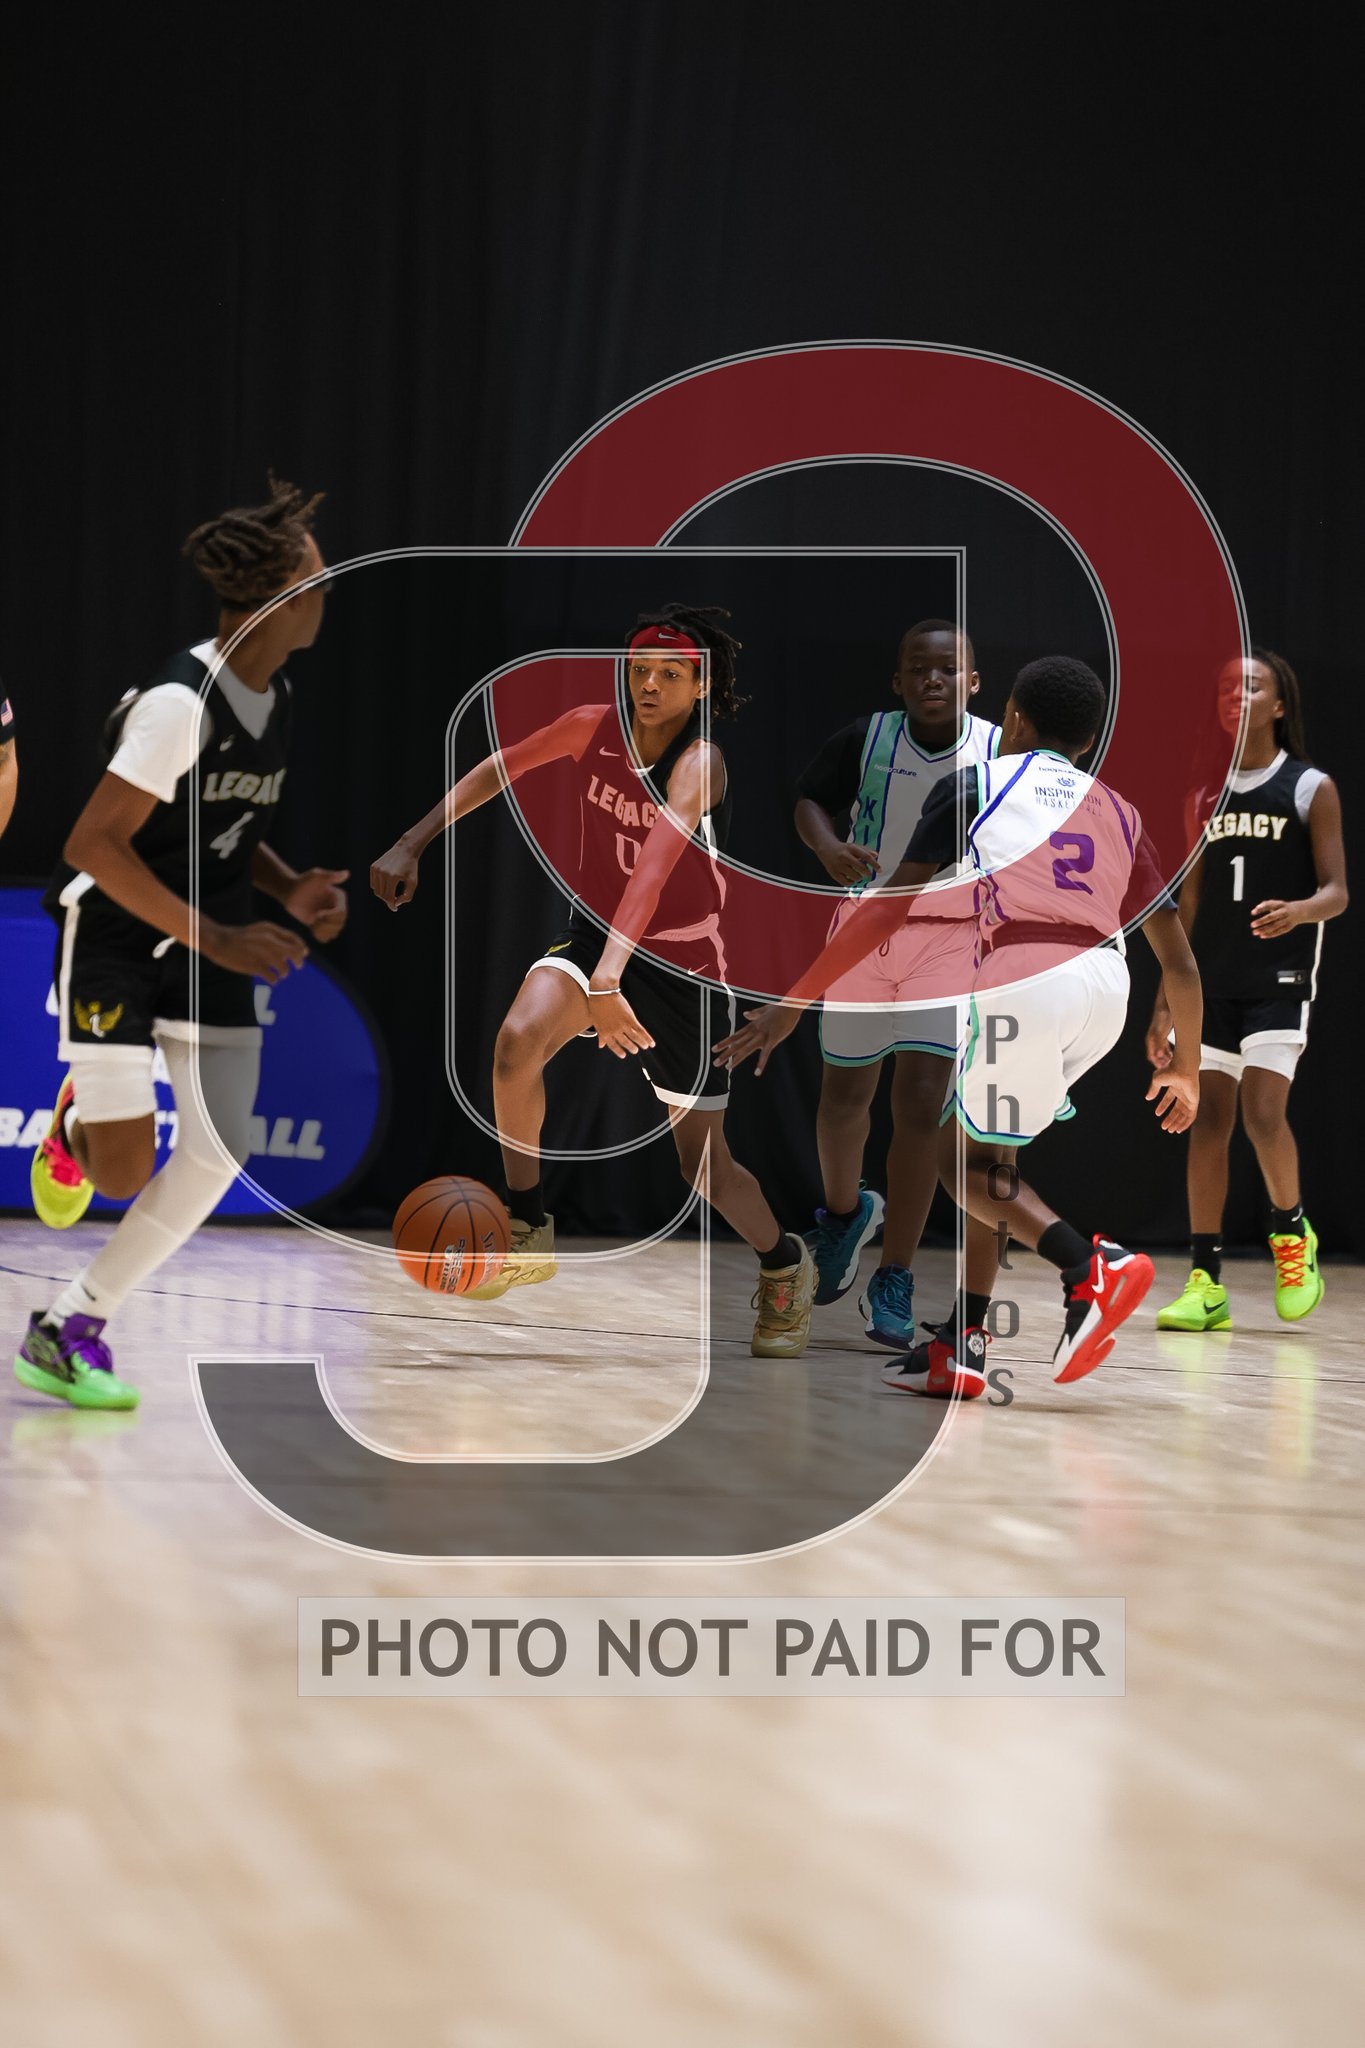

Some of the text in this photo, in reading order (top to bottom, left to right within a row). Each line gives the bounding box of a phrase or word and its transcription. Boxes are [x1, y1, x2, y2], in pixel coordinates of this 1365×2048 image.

[202, 767, 286, 805] LEGA
[587, 774, 664, 829] LEGAC
[1034, 786, 1102, 808] INSPIRION
[209, 811, 254, 859] 4
[1203, 812, 1288, 843] LEGACY
[1049, 831, 1095, 896] 2
[1229, 855, 1245, 902] 1
